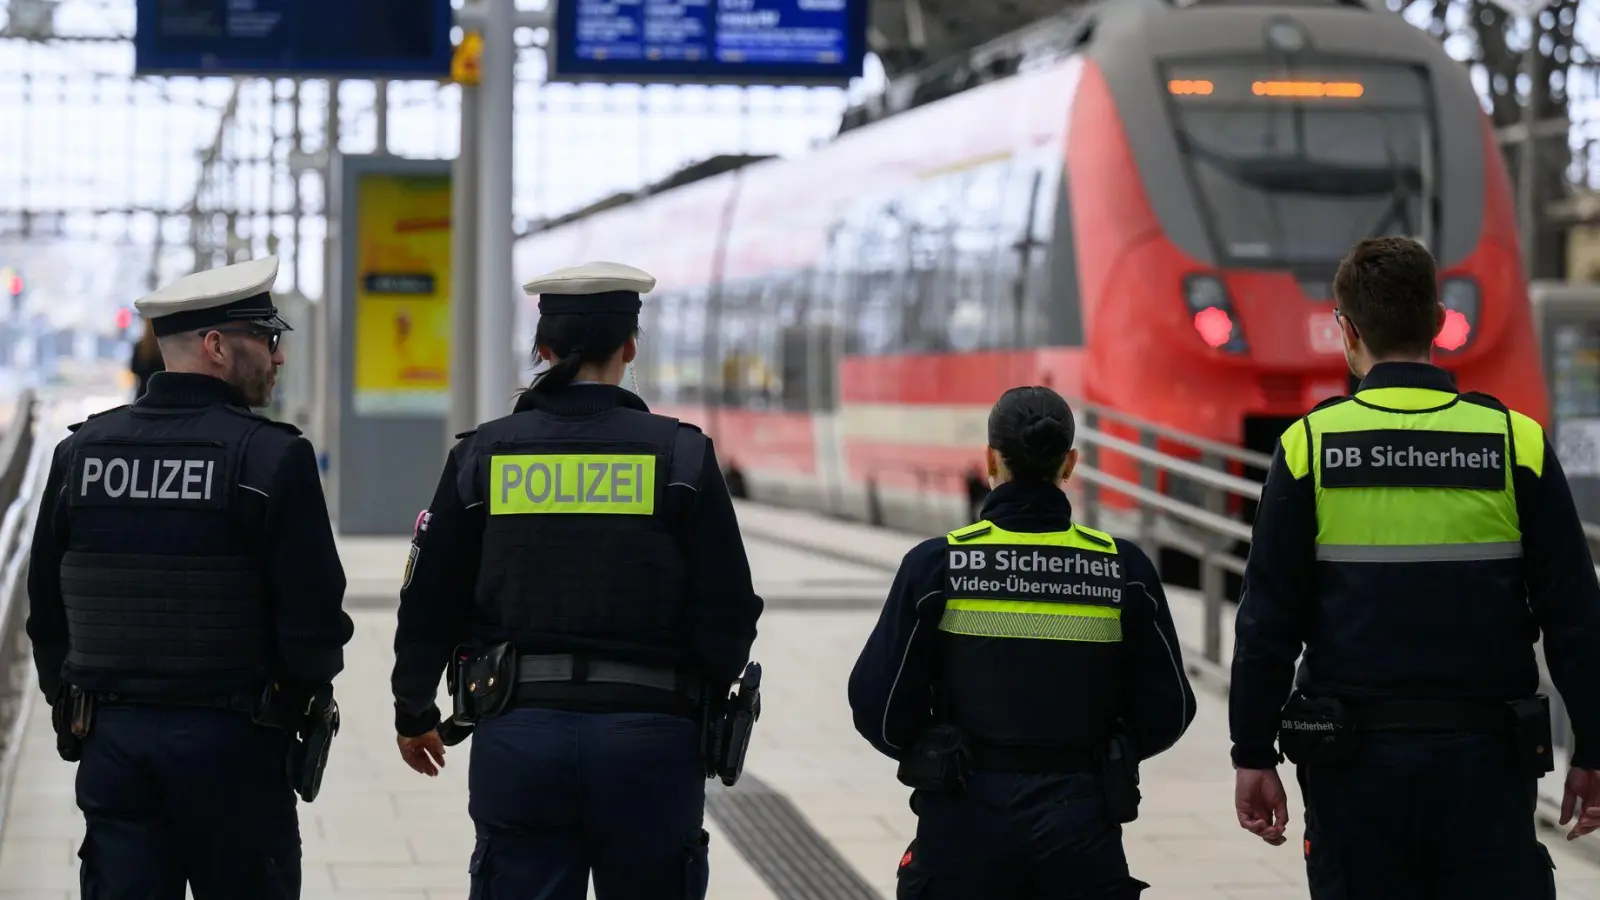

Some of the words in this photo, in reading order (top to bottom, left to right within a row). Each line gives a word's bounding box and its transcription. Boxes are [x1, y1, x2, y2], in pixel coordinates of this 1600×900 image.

[1325, 447, 1362, 468] DB
[1370, 445, 1500, 469] Sicherheit
[80, 457, 215, 500] POLIZEI
[501, 462, 643, 504] POLIZEI
[949, 550, 986, 570] DB
[995, 550, 1121, 578] Sicherheit
[950, 575, 1121, 603] Video-Überwachung
[1282, 720, 1293, 729] DB
[1294, 721, 1334, 731] Sicherheit
